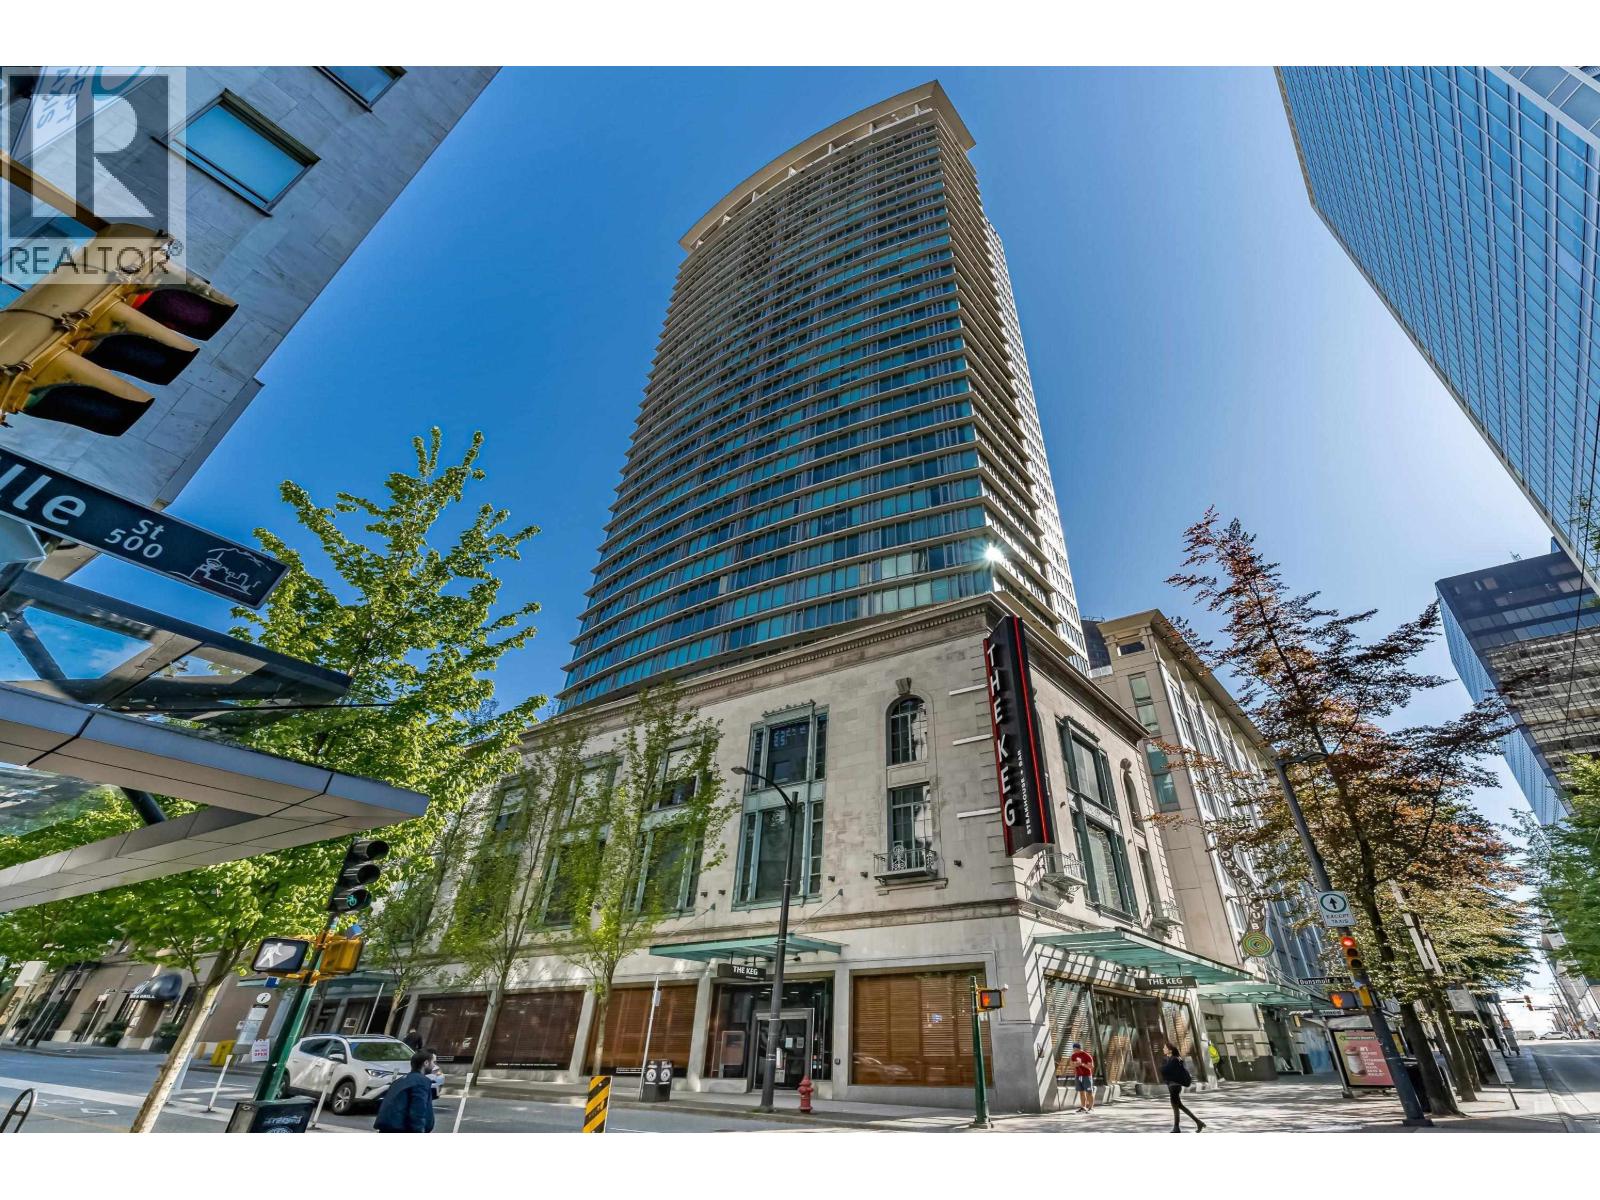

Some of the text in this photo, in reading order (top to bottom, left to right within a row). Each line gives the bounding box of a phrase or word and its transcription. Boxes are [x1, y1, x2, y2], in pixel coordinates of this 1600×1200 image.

[104, 528, 163, 559] 500
[132, 519, 165, 541] St
[987, 643, 1016, 827] THE KEG
[1021, 778, 1032, 835] STEAKHOUSE
[733, 965, 758, 975] THE KEG
